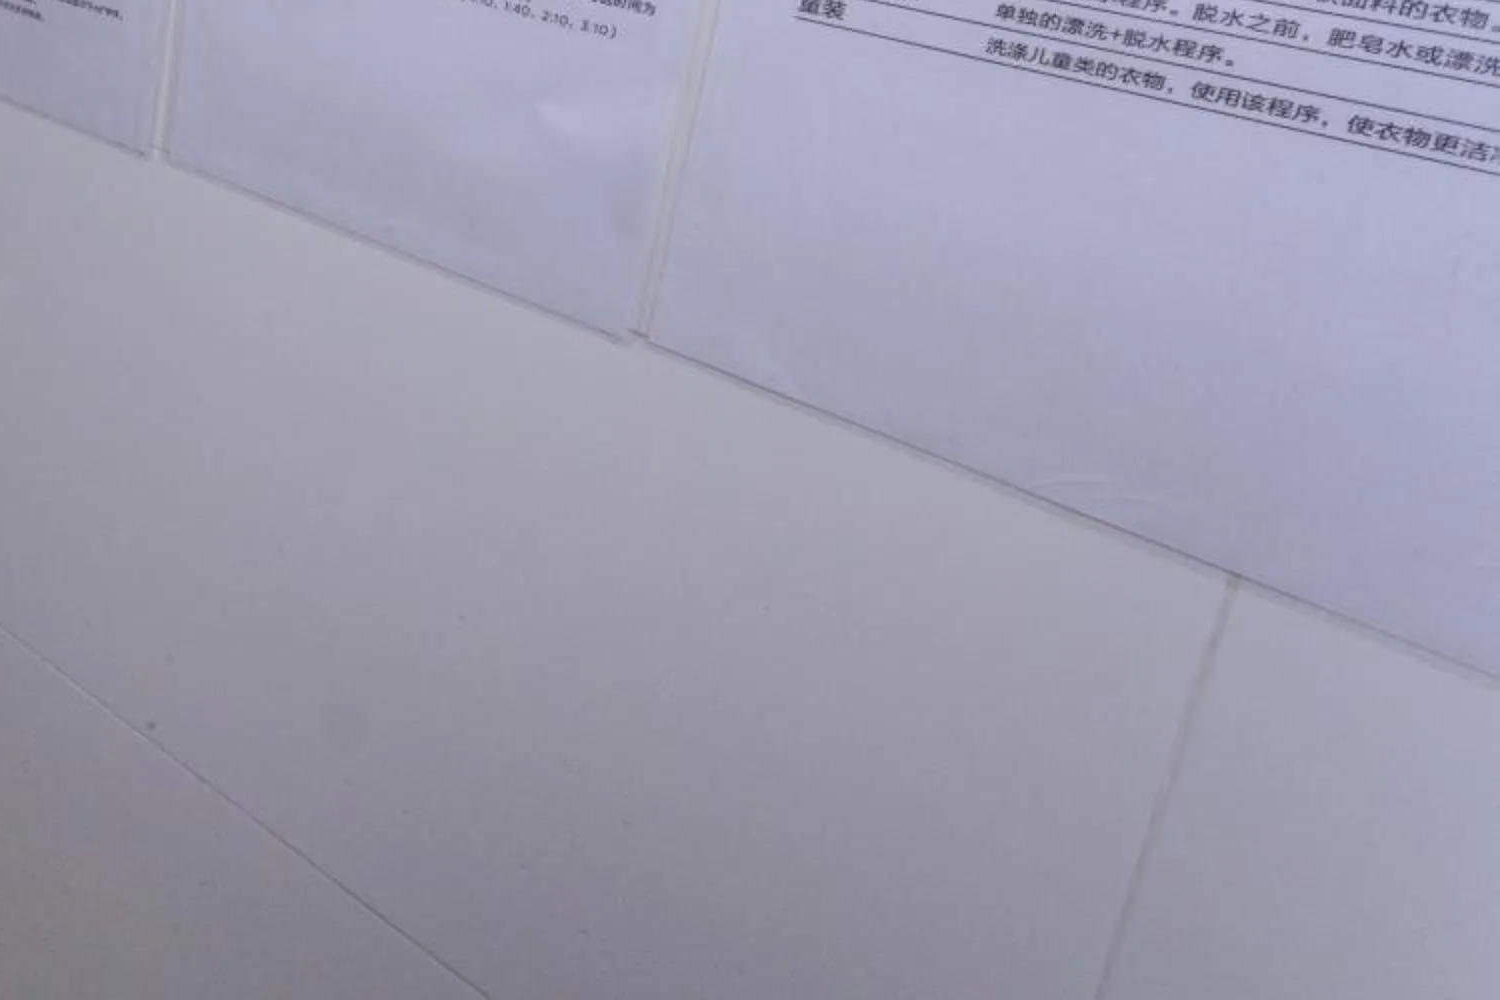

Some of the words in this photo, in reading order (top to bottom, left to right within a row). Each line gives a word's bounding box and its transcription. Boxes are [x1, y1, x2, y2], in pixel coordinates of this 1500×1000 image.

[994, 2, 1236, 68] 单独的漂洗+脱水程序。
